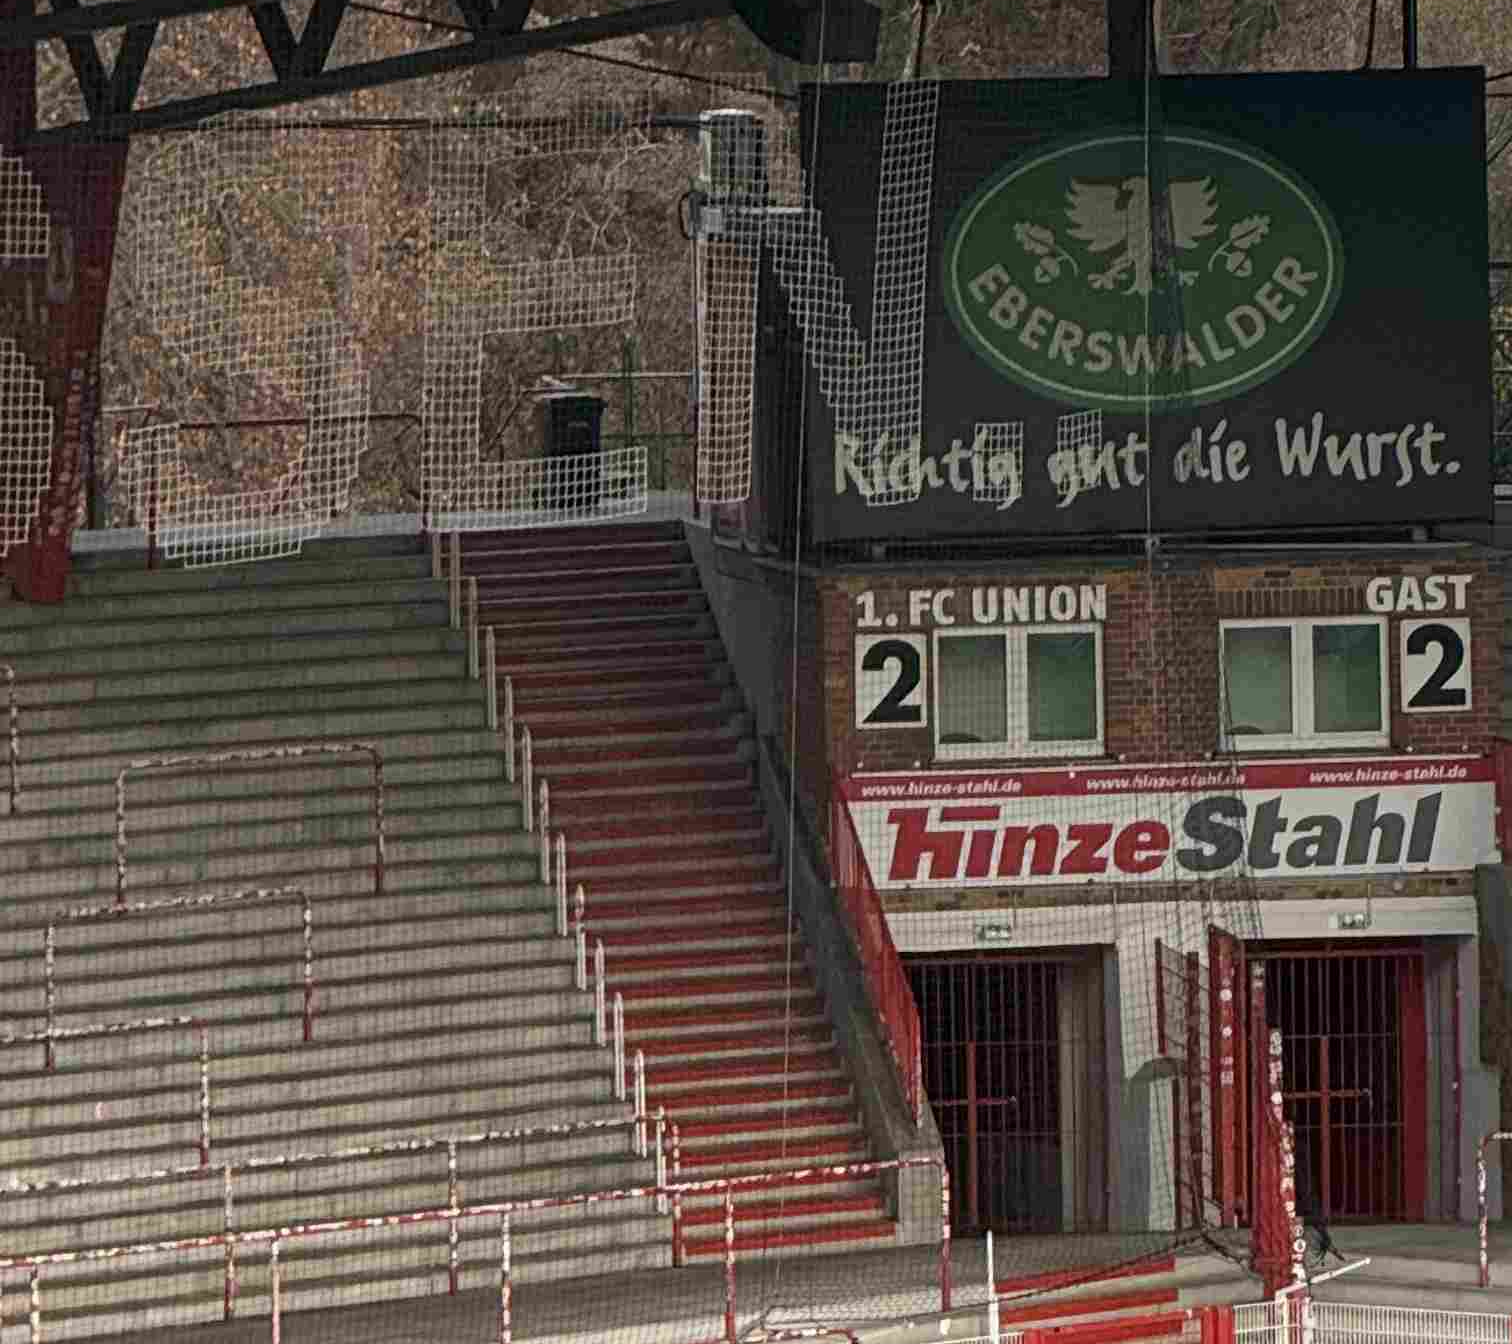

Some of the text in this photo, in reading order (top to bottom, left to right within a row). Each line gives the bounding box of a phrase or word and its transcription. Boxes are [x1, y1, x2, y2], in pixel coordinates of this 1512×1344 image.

[968, 255, 1319, 376] EBERSWALDER
[834, 412, 1461, 511] Richtig gut die Wurst.
[856, 584, 1107, 627] 1. FC UNION
[1367, 574, 1472, 613] GAST
[862, 640, 921, 724] 2
[1405, 623, 1466, 708] 2
[1310, 765, 1467, 783] www.hinze-stahl.de
